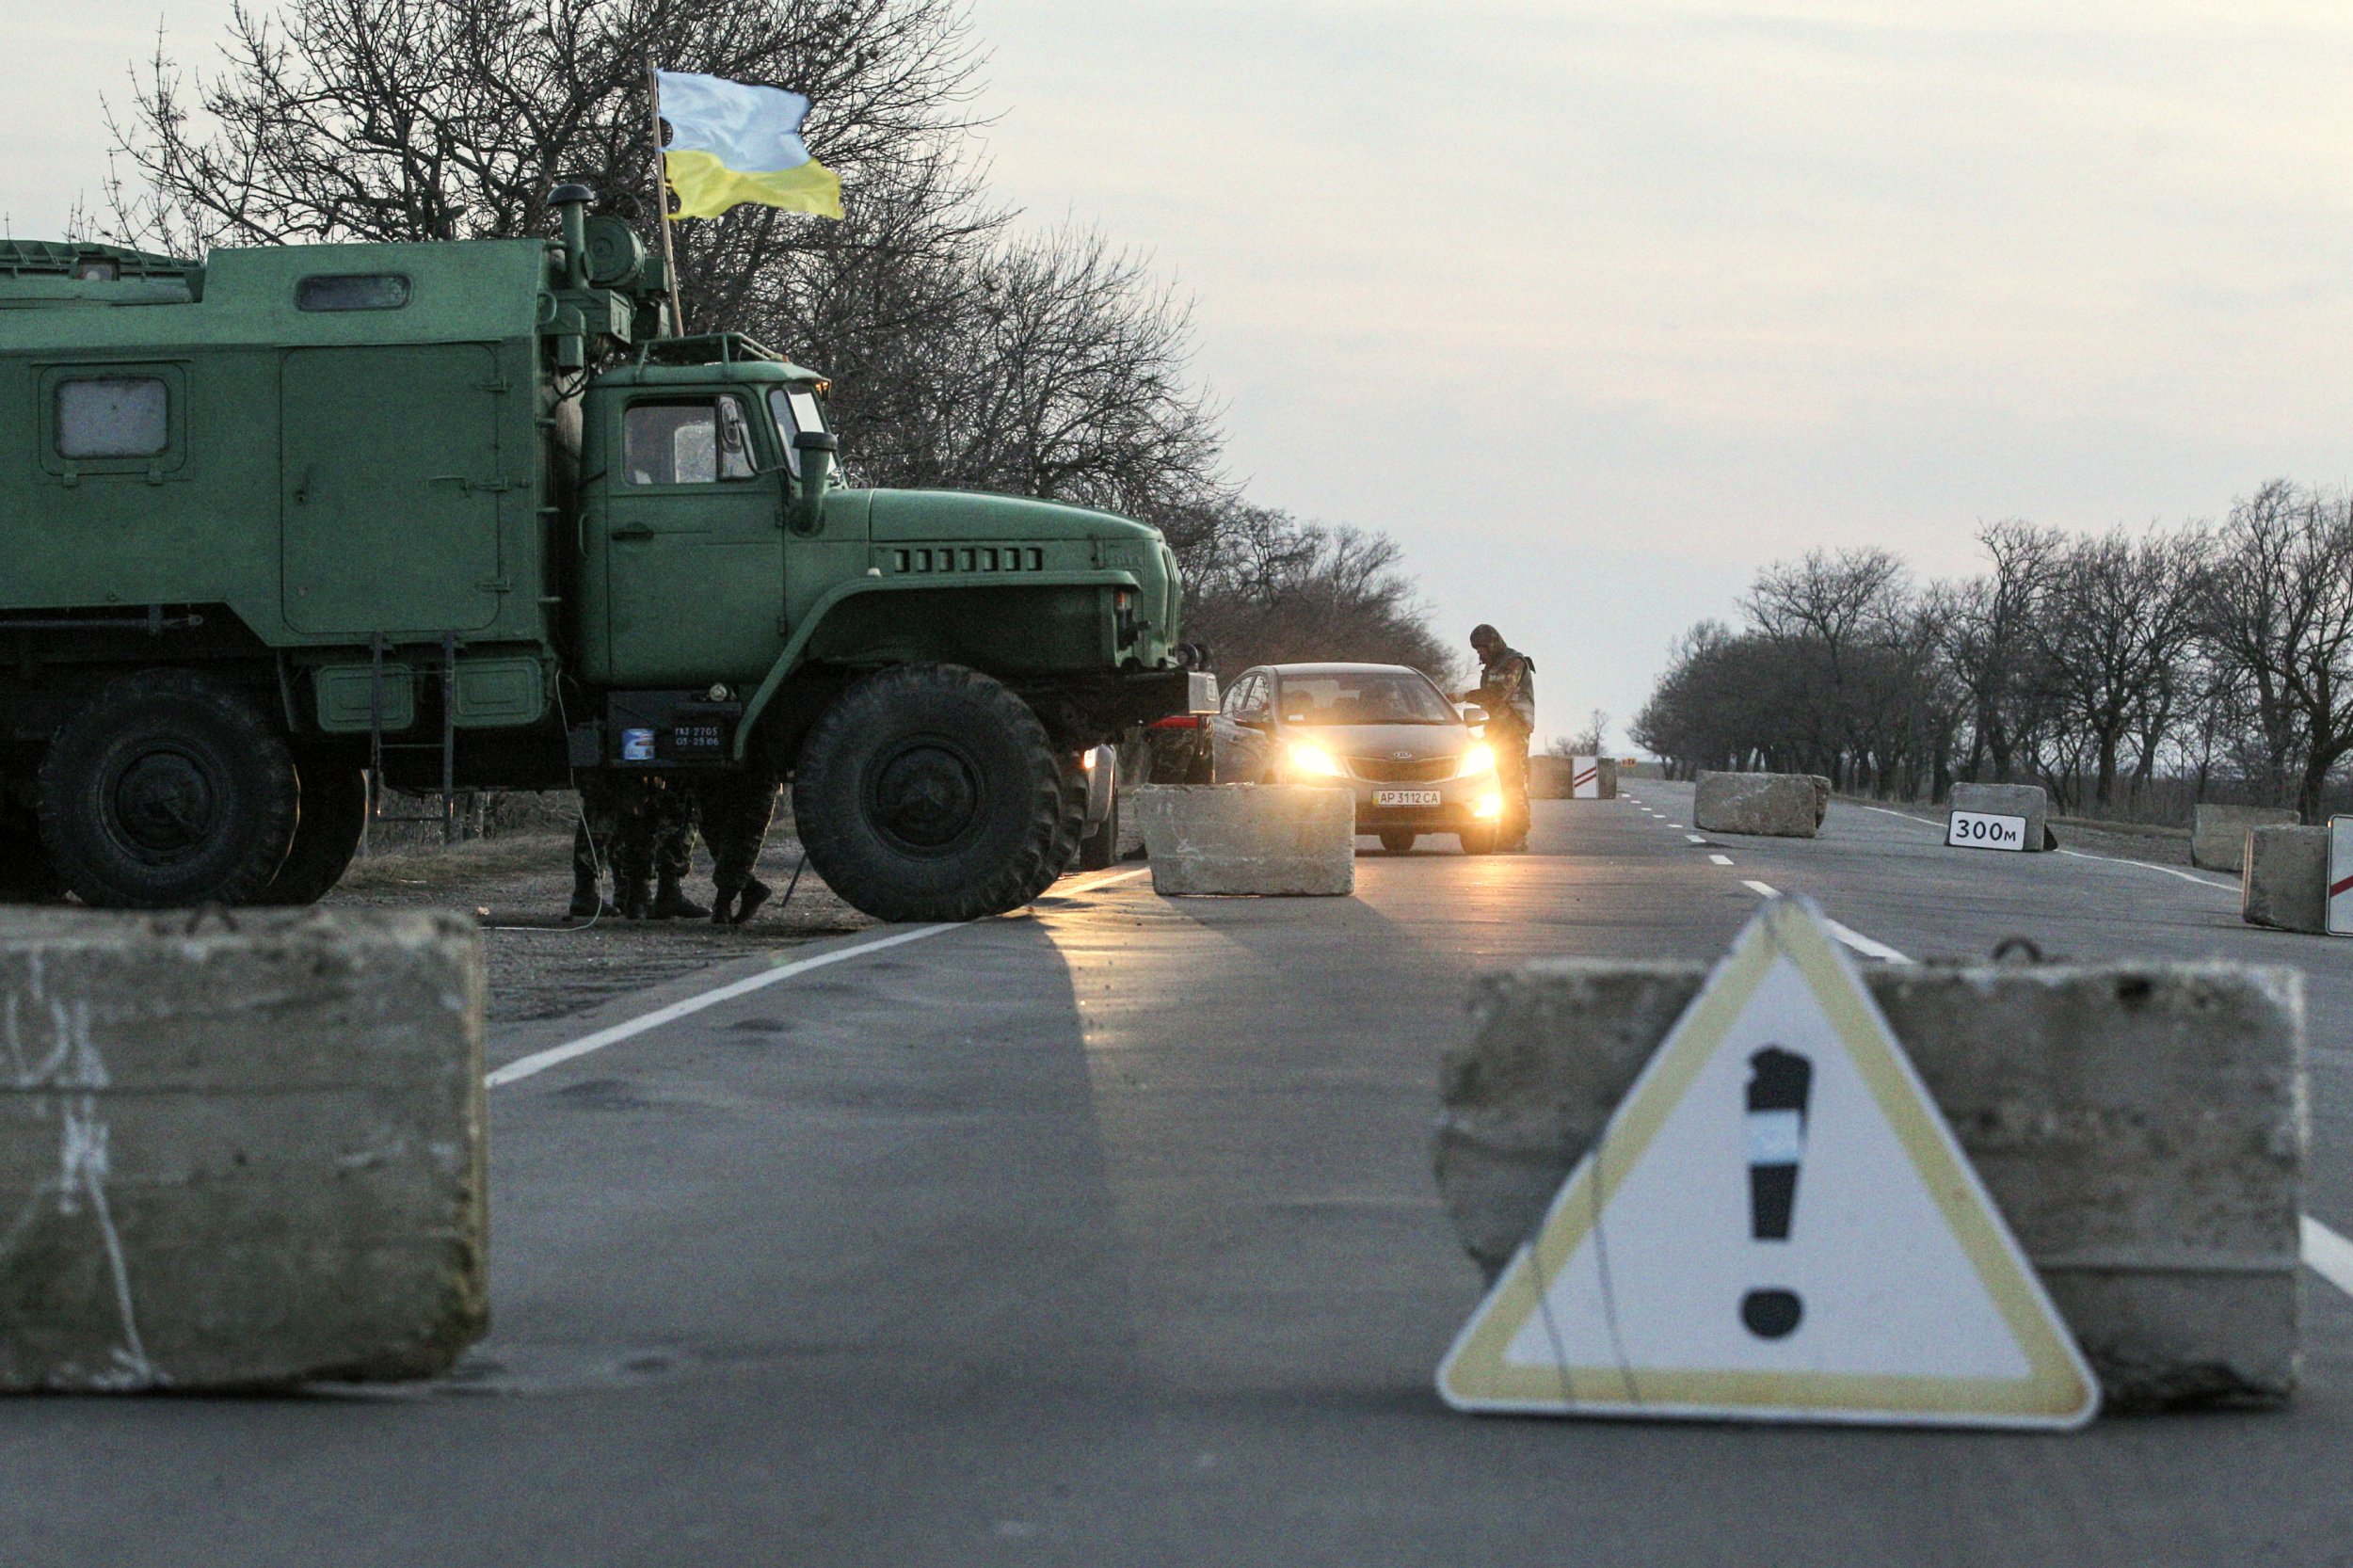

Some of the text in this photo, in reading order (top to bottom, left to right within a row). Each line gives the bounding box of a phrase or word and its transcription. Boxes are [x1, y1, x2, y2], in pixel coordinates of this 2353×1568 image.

[1380, 792, 1438, 803] AP 3112 CA
